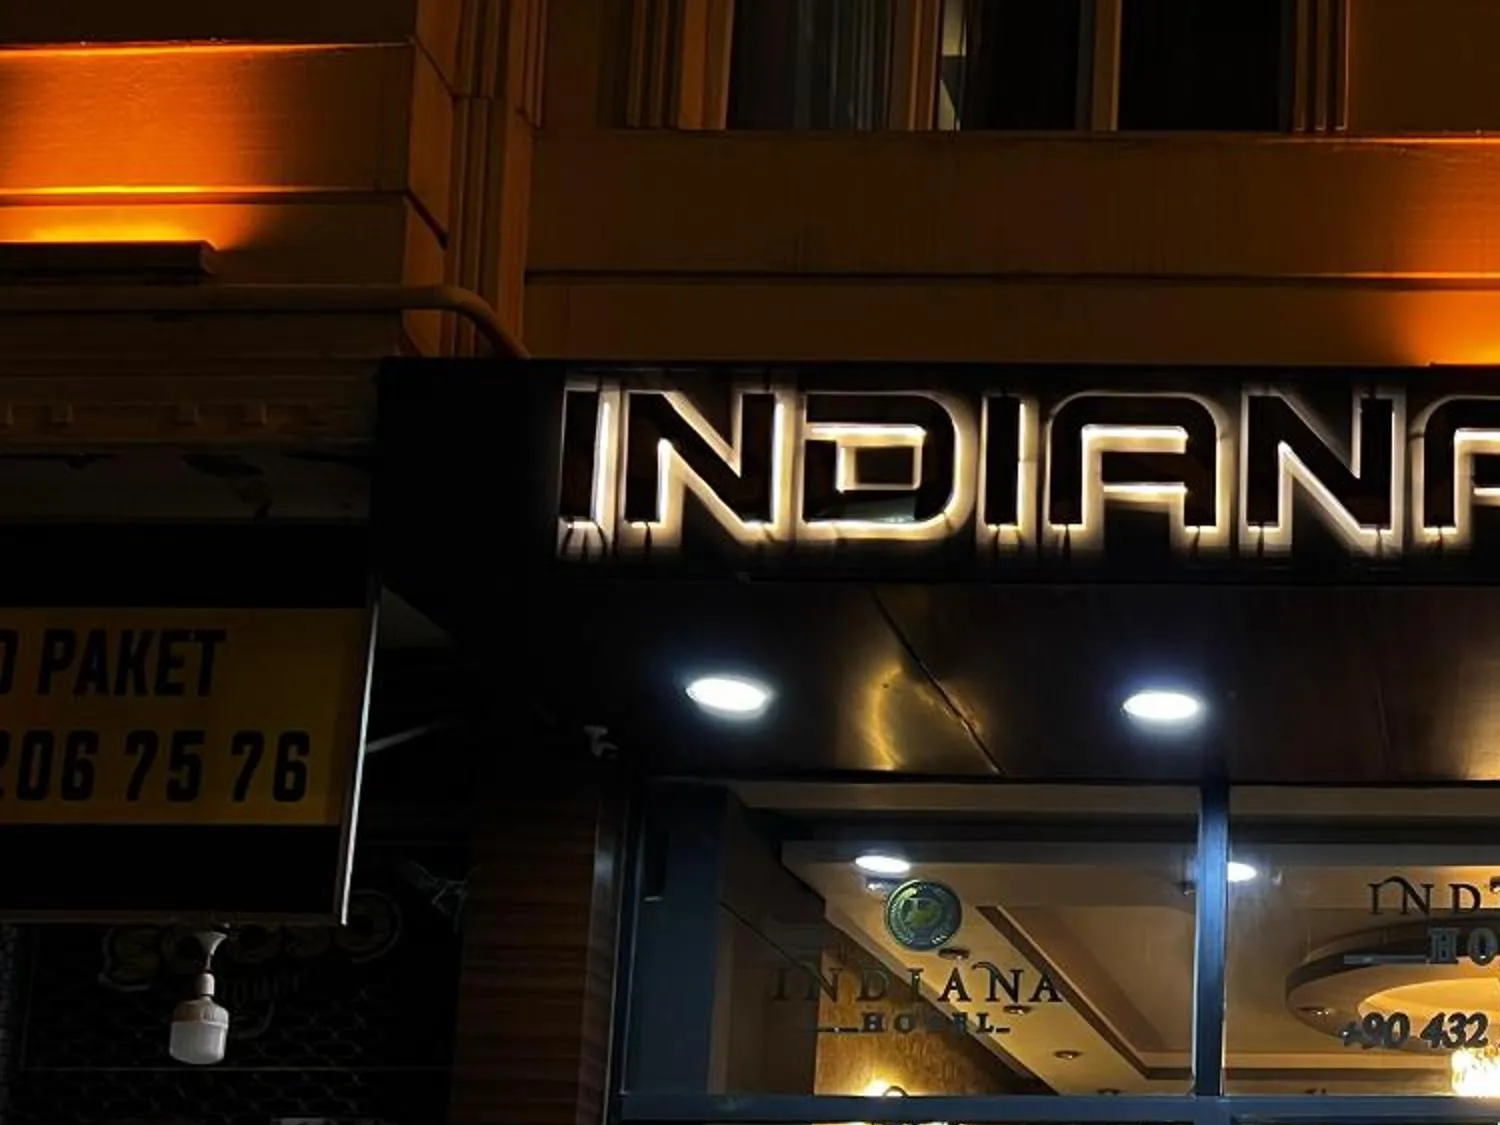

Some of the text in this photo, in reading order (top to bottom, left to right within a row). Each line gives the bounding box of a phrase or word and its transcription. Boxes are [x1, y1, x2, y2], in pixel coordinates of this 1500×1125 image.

[38, 628, 227, 696] PAKET
[124, 731, 206, 802] 75
[231, 731, 311, 802] 76
[772, 961, 1064, 1004] INDIANA
[1340, 1011, 1410, 1050] +90
[1420, 1011, 1489, 1050] 432
